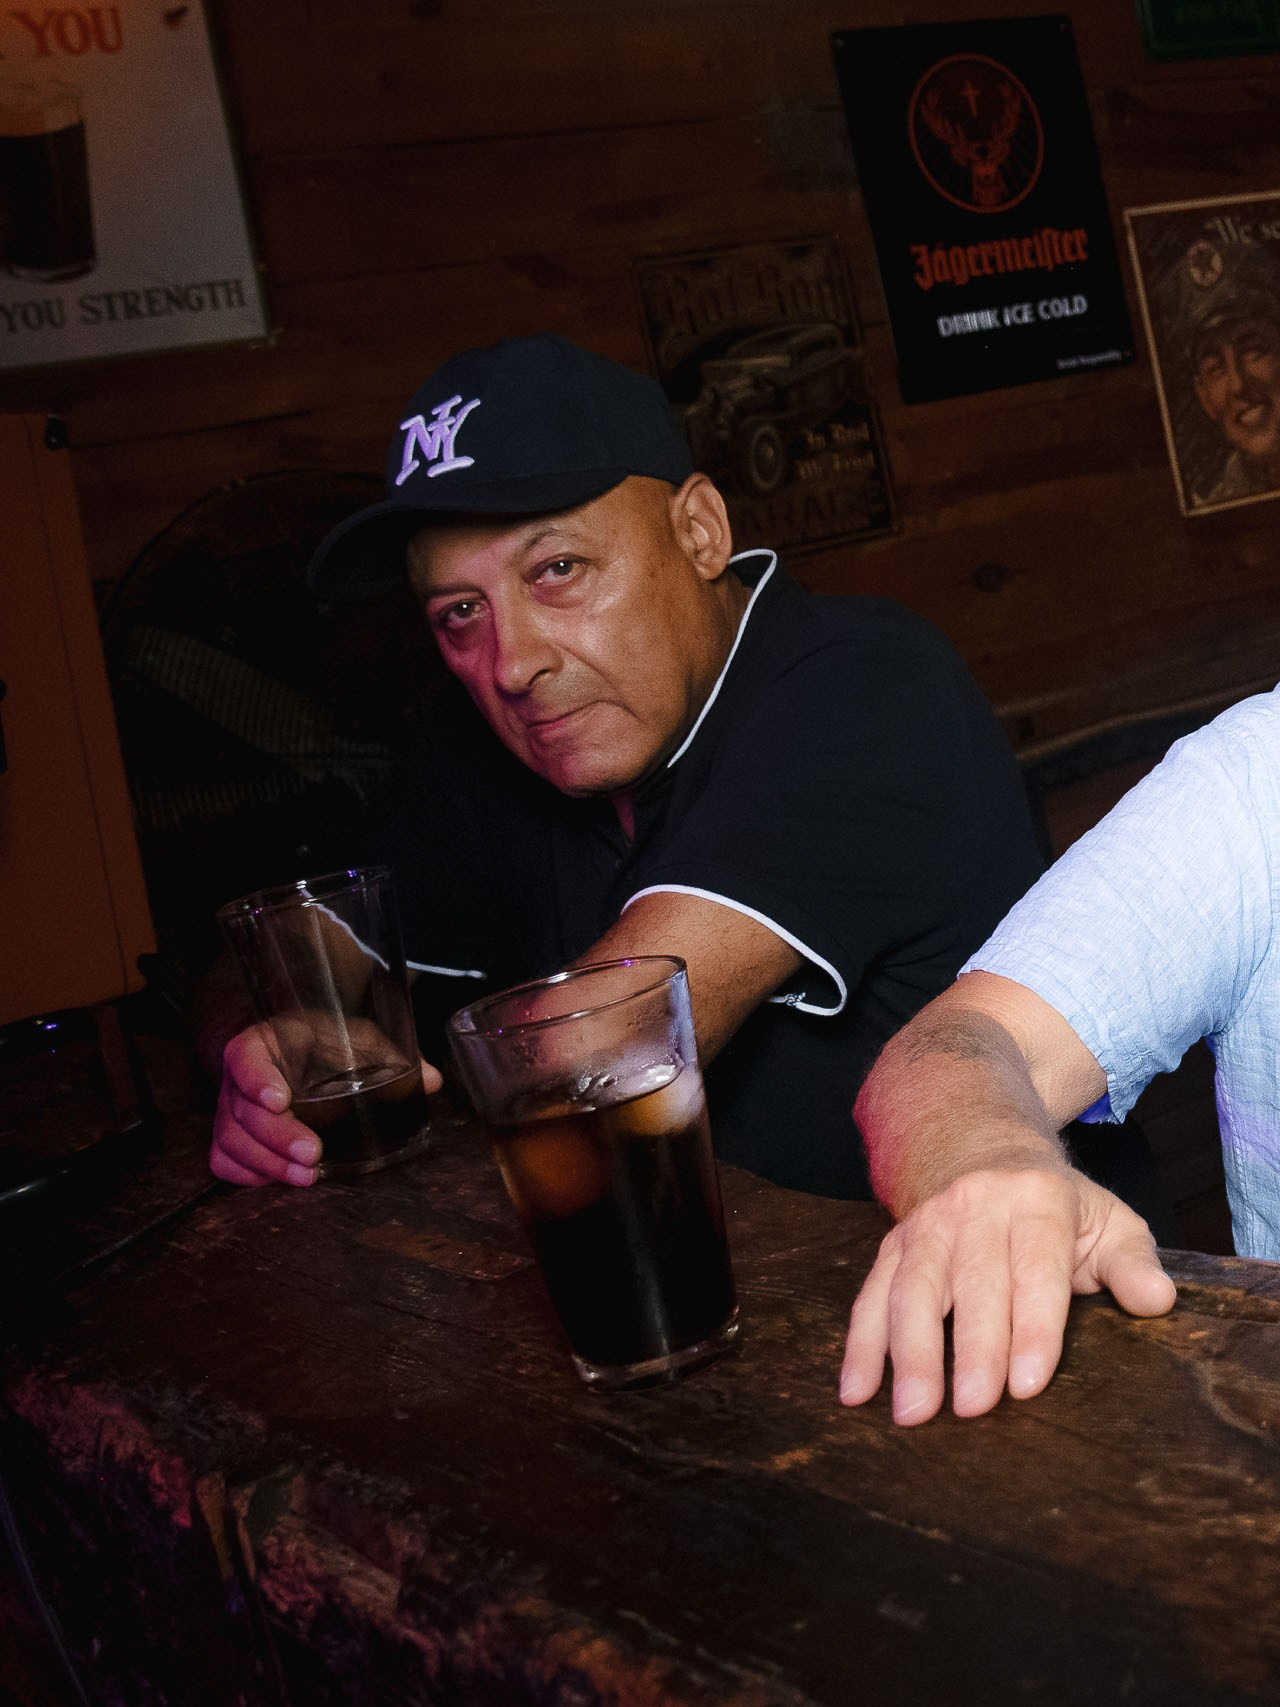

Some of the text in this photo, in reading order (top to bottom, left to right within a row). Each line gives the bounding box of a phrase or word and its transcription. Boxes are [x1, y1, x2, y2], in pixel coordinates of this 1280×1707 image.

[10, 5, 124, 58] YOU
[0, 278, 248, 333] YOU STRENGTH
[935, 292, 1090, 338] DRINK ICE COLD
[395, 394, 481, 486] NY
